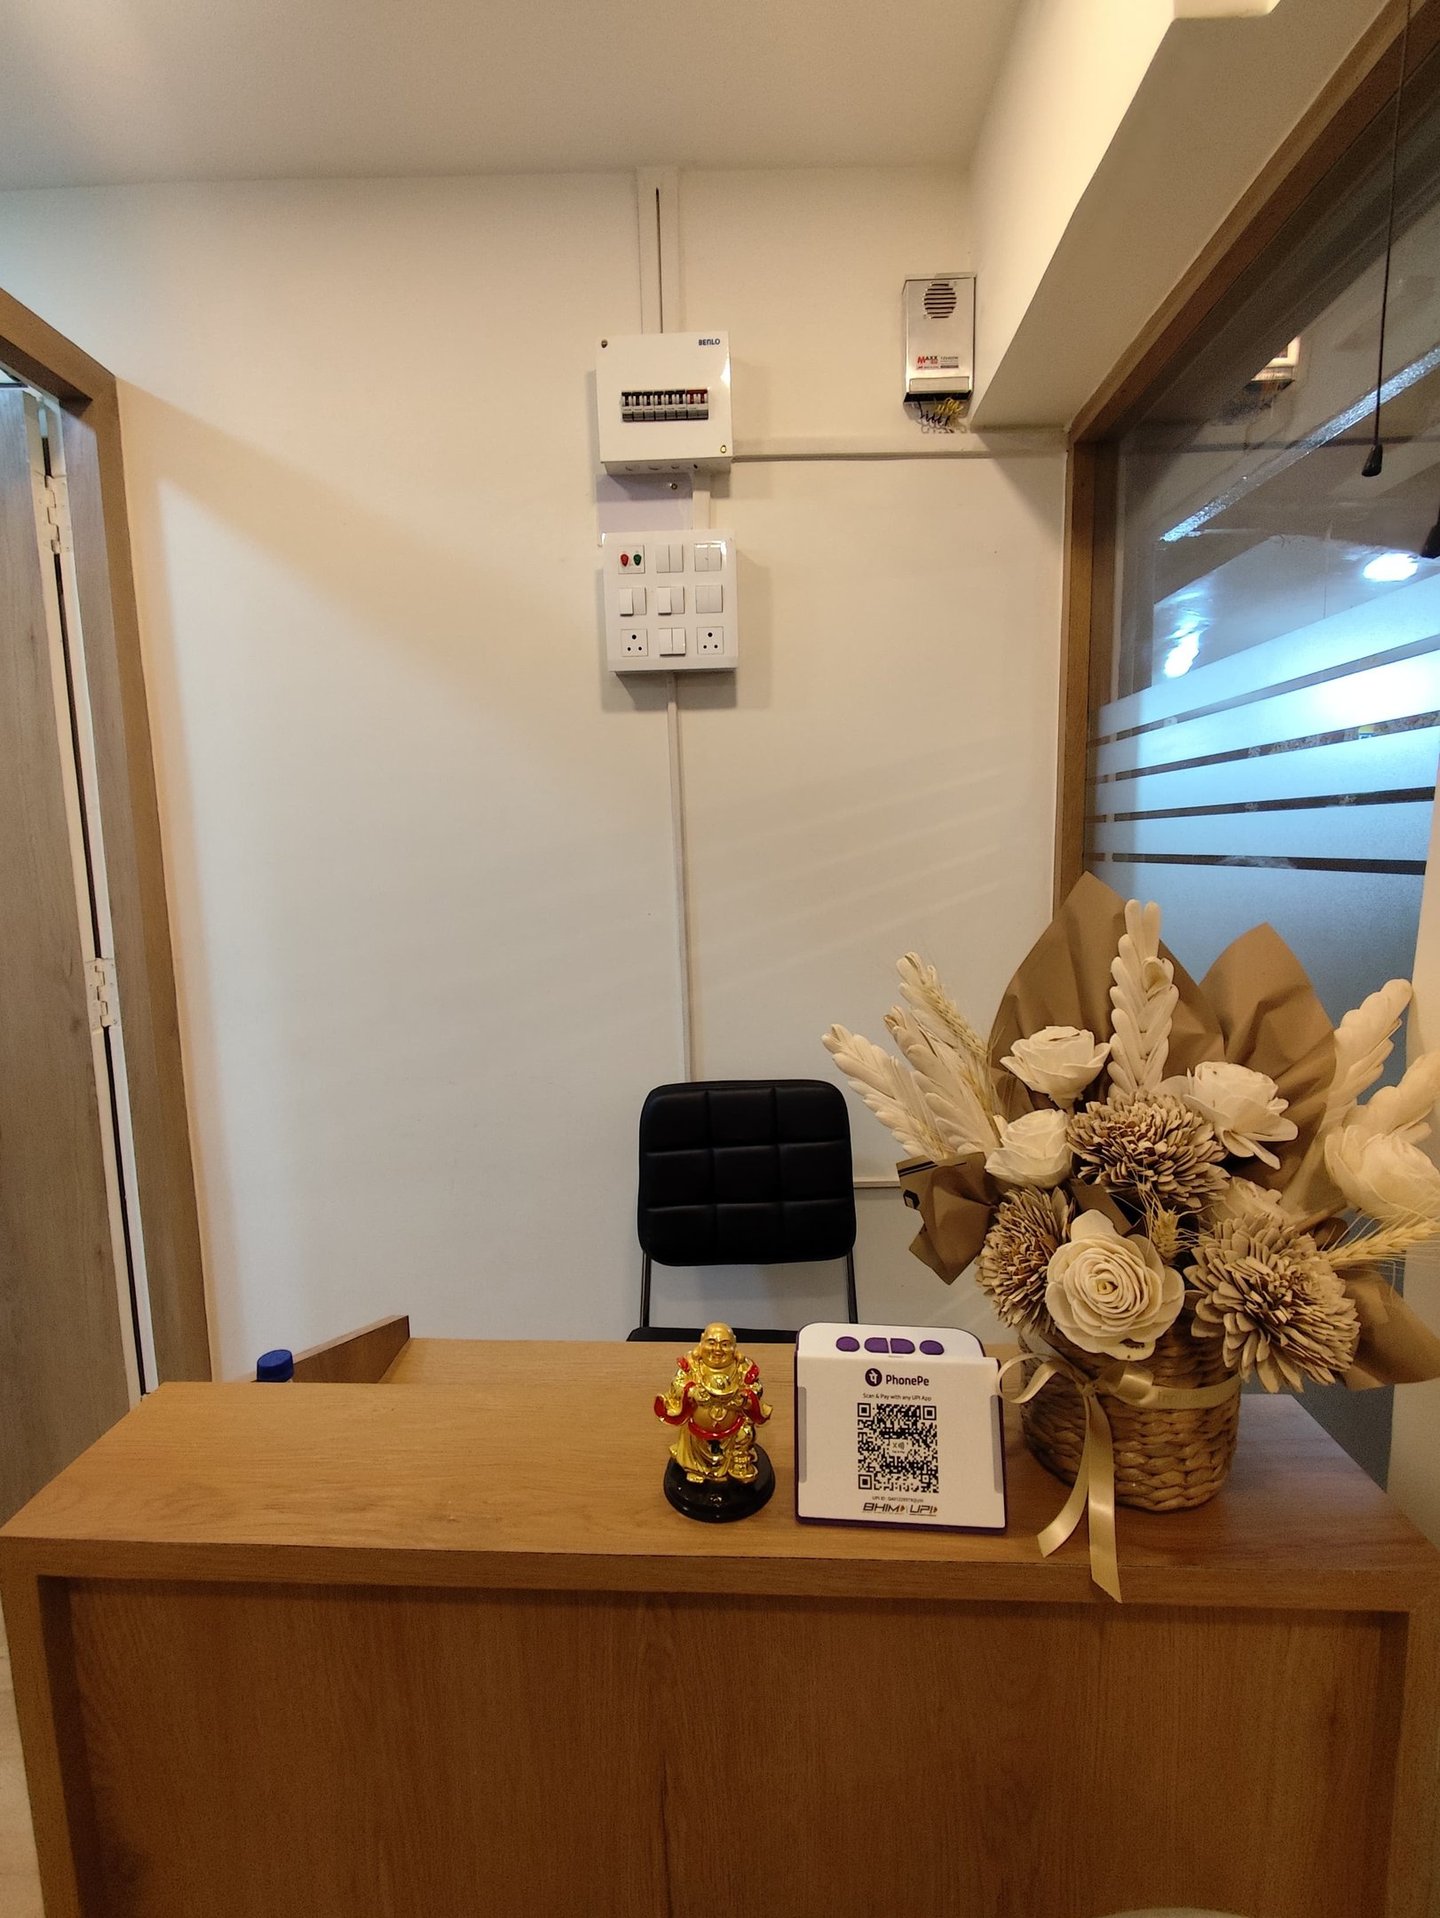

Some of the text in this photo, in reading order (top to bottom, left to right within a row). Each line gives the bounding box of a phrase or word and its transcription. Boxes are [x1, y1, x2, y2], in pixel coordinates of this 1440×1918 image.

[886, 1374, 930, 1387] PhonePe
[863, 1502, 934, 1514] BHIM UPI
